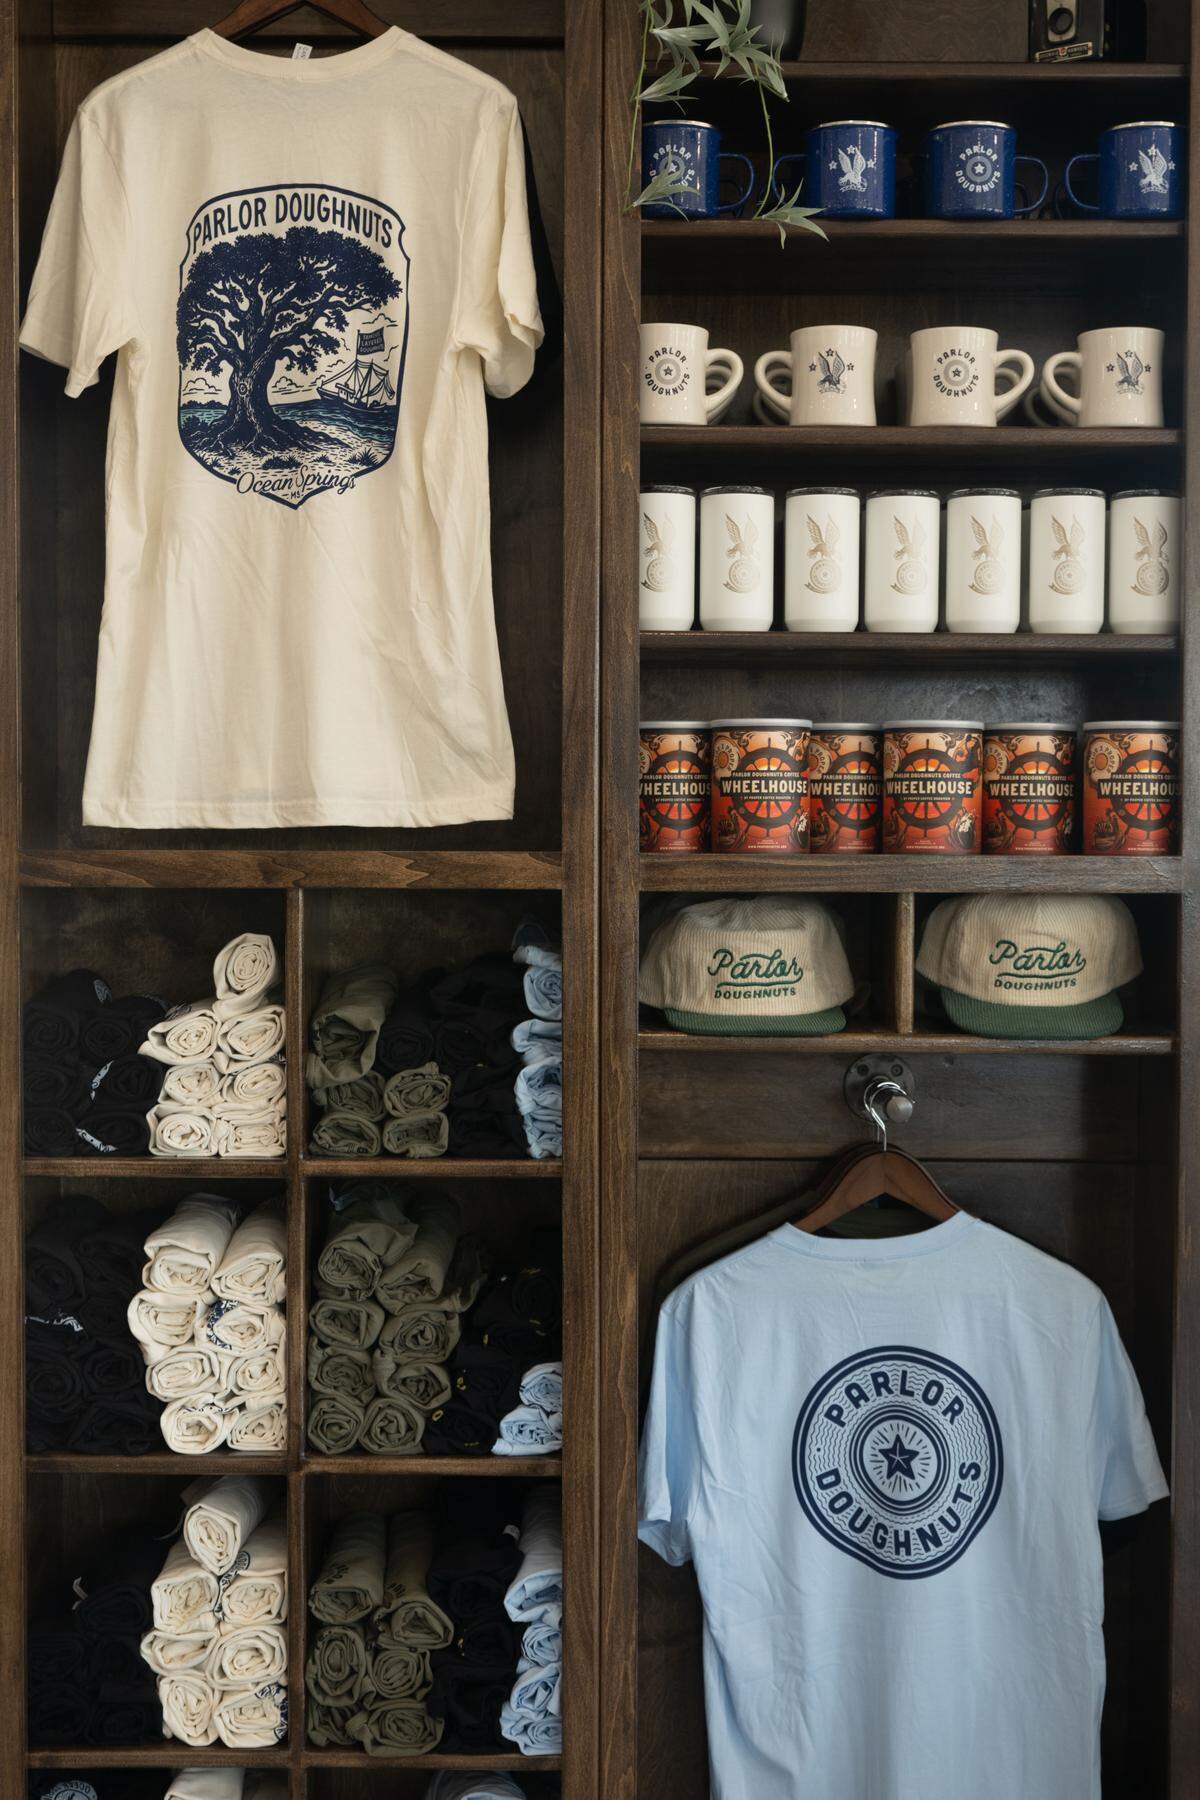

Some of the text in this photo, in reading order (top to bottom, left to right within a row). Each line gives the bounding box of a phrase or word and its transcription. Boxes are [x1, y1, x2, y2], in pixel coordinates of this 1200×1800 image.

[653, 144, 692, 160] PARLOR
[959, 145, 998, 162] PARLOR
[955, 170, 1001, 193] DOUGHNUTS
[192, 192, 392, 254] PARLOR DOUGHNUTS
[648, 347, 687, 363] PARLOR
[937, 349, 976, 365] PARLOR
[645, 373, 690, 396] DOUGHNUTS
[933, 374, 979, 397] DOUGHNUTS
[236, 465, 356, 494] Ocean Springs
[640, 782, 711, 796] HEELHOUS
[722, 780, 807, 793] WHEELHOUSE
[811, 782, 880, 796] WHEELHOU
[886, 780, 972, 794] WHEELHOUSE
[989, 783, 1074, 797] WHEELHOUSE
[1100, 782, 1179, 796] WHEELHOU
[989, 940, 1087, 974] Parlor
[707, 948, 803, 983] Parlor
[994, 978, 1077, 991] DOUGHNUTS
[714, 987, 796, 999] DOUGHNUTS
[824, 1369, 965, 1428] PARLOR
[816, 1461, 982, 1557] DOUGHNUTS
